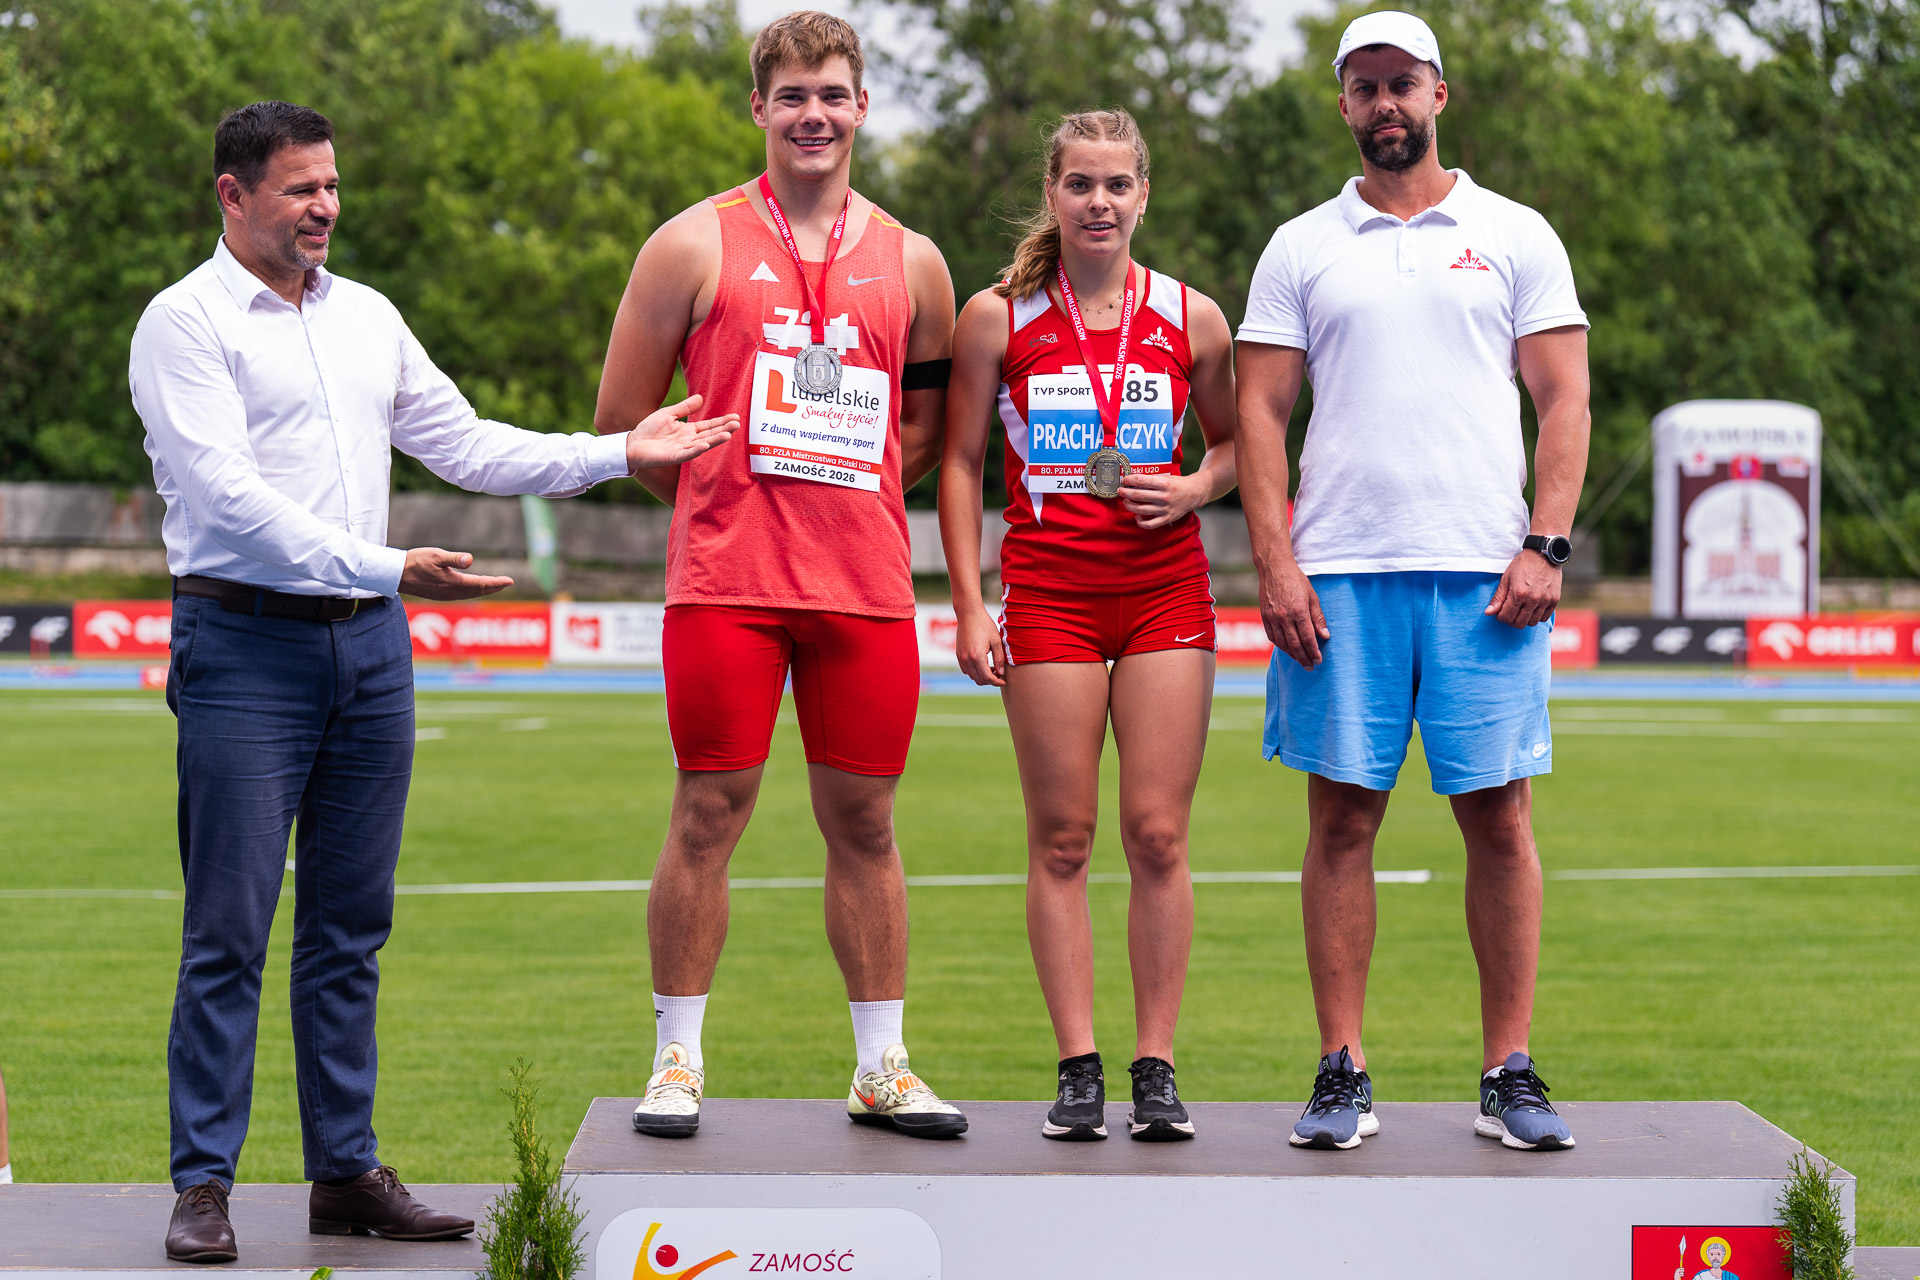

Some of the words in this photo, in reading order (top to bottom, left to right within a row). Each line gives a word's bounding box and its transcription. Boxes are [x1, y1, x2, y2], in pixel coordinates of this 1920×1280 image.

[766, 196, 790, 240] MISTRZOSTWA
[1058, 269, 1071, 293] POLSKI
[1065, 292, 1087, 341] MISTRZOSTWA
[1120, 289, 1134, 337] MISTRZOSTWA
[1117, 337, 1129, 362] POLSKI
[1114, 362, 1125, 380] 2026
[1033, 387, 1055, 396] TVP
[1057, 387, 1091, 396] SPORT
[1109, 380, 1159, 403] 85
[801, 405, 847, 429] Smakuj
[847, 411, 879, 429] życie!
[760, 423, 769, 432] Z
[770, 421, 797, 438] dumą
[799, 430, 852, 446] wspieramy
[852, 438, 876, 450] sport
[1033, 423, 1168, 450] PRACHACZYK
[759, 446, 771, 455] 80.
[773, 448, 791, 458] PZLA
[792, 450, 837, 465] Mistrzostwa
[837, 458, 858, 469] Polski
[858, 461, 872, 471] U20
[1040, 467, 1053, 475] 80.
[1054, 467, 1072, 475] PZLA
[1145, 466, 1160, 474] U20
[774, 461, 827, 478] ZAMOŚĆ
[828, 470, 856, 483] 2026
[454, 617, 547, 647] ORLEN
[1806, 627, 1897, 655] ORLEN
[748, 1248, 855, 1273] ZAMOŚĆ
